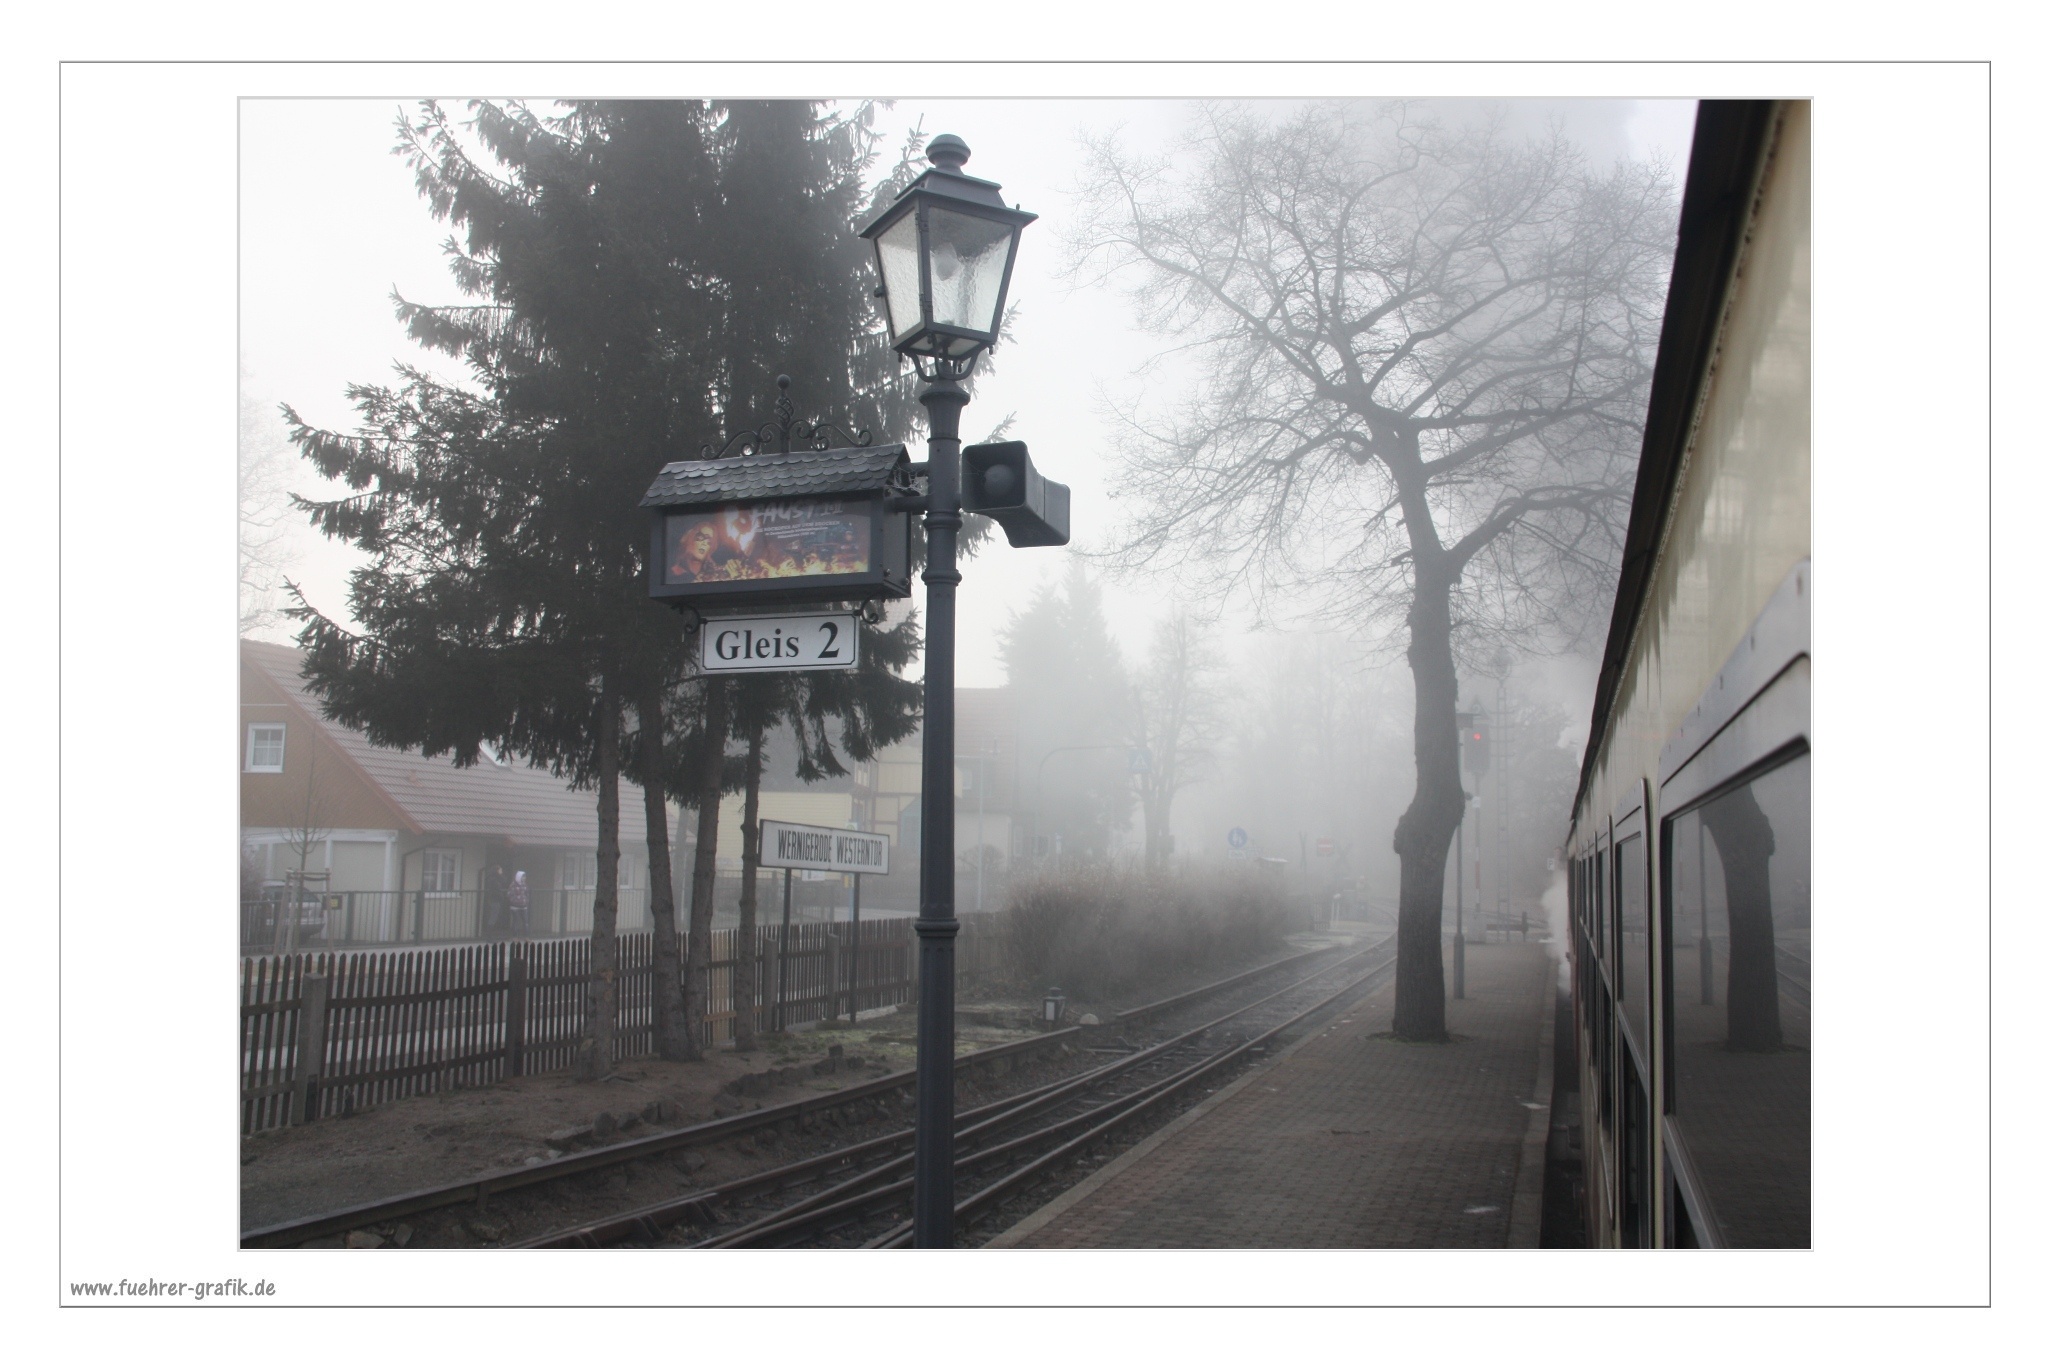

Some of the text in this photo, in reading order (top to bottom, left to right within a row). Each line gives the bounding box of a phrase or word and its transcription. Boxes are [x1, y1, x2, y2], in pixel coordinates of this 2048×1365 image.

[716, 621, 840, 660] Gleis 2
[778, 829, 883, 866] WERNIGERODE WESTERNTOR
